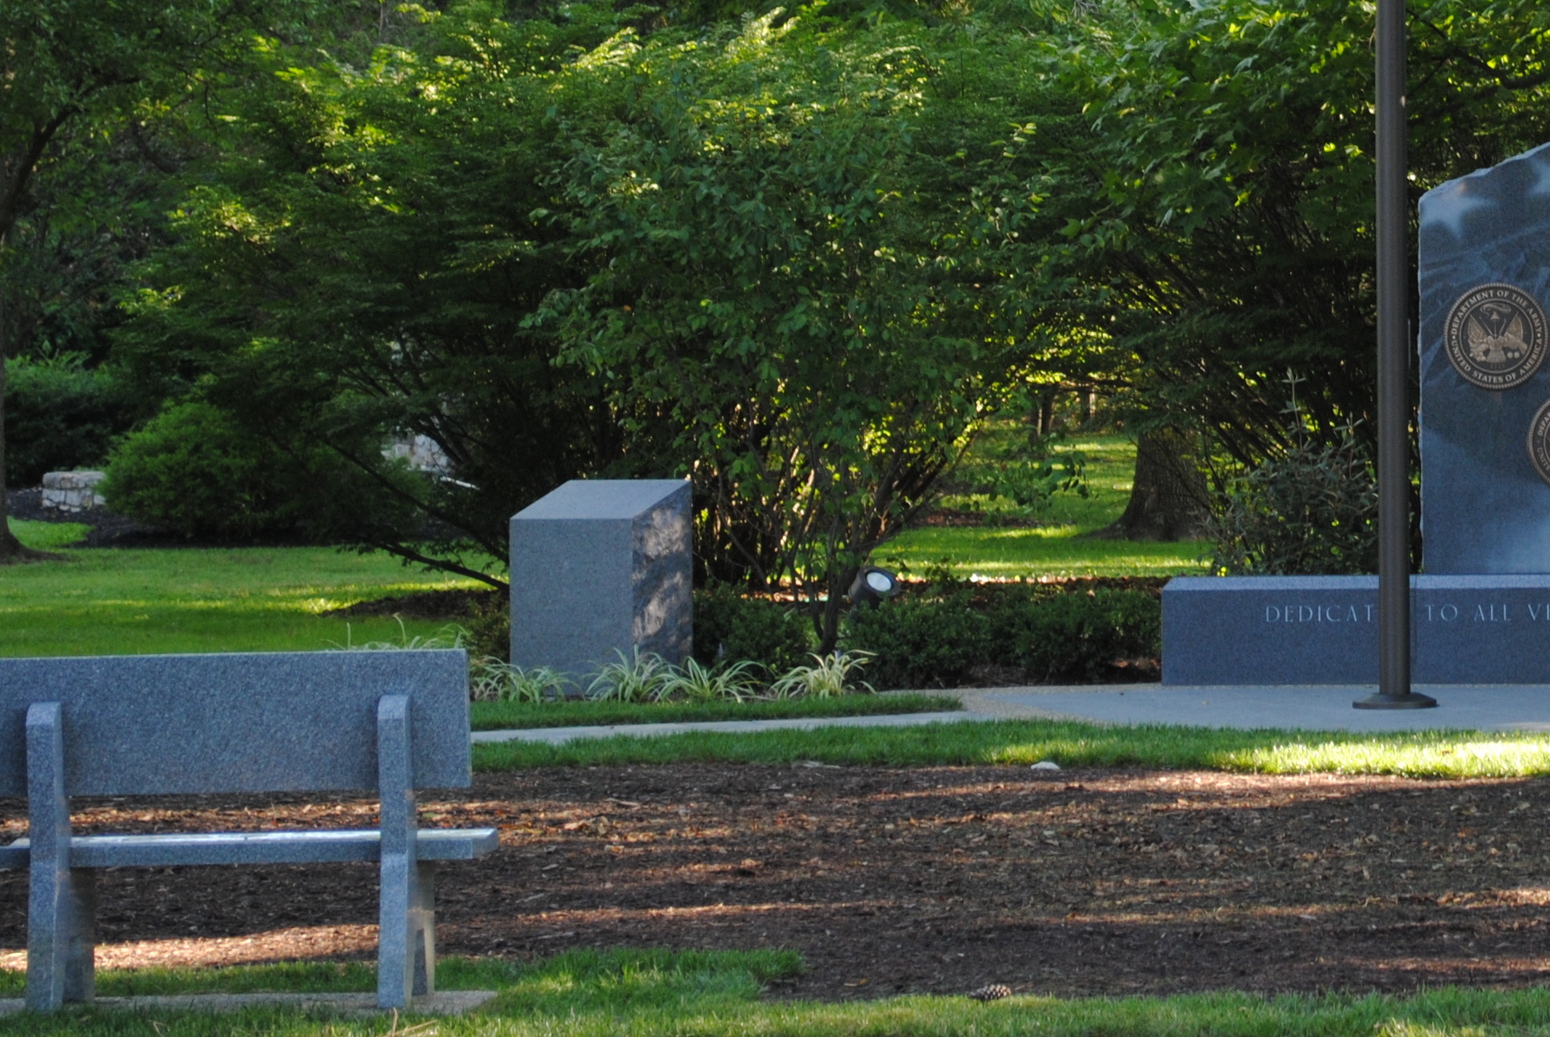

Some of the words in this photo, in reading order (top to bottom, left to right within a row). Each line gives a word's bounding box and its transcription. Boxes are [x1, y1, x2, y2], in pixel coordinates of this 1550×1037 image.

[1451, 290, 1494, 333] DEPARTMENT
[1512, 293, 1527, 307] THE
[1527, 308, 1542, 332] ARMY
[1451, 340, 1471, 372] UNITED
[1473, 371, 1503, 383] STATES
[1505, 373, 1517, 382] OF
[1520, 339, 1542, 376] AMERICA
[1265, 605, 1376, 623] DEDICAT
[1425, 604, 1458, 622] TO
[1473, 604, 1511, 622] ALL
